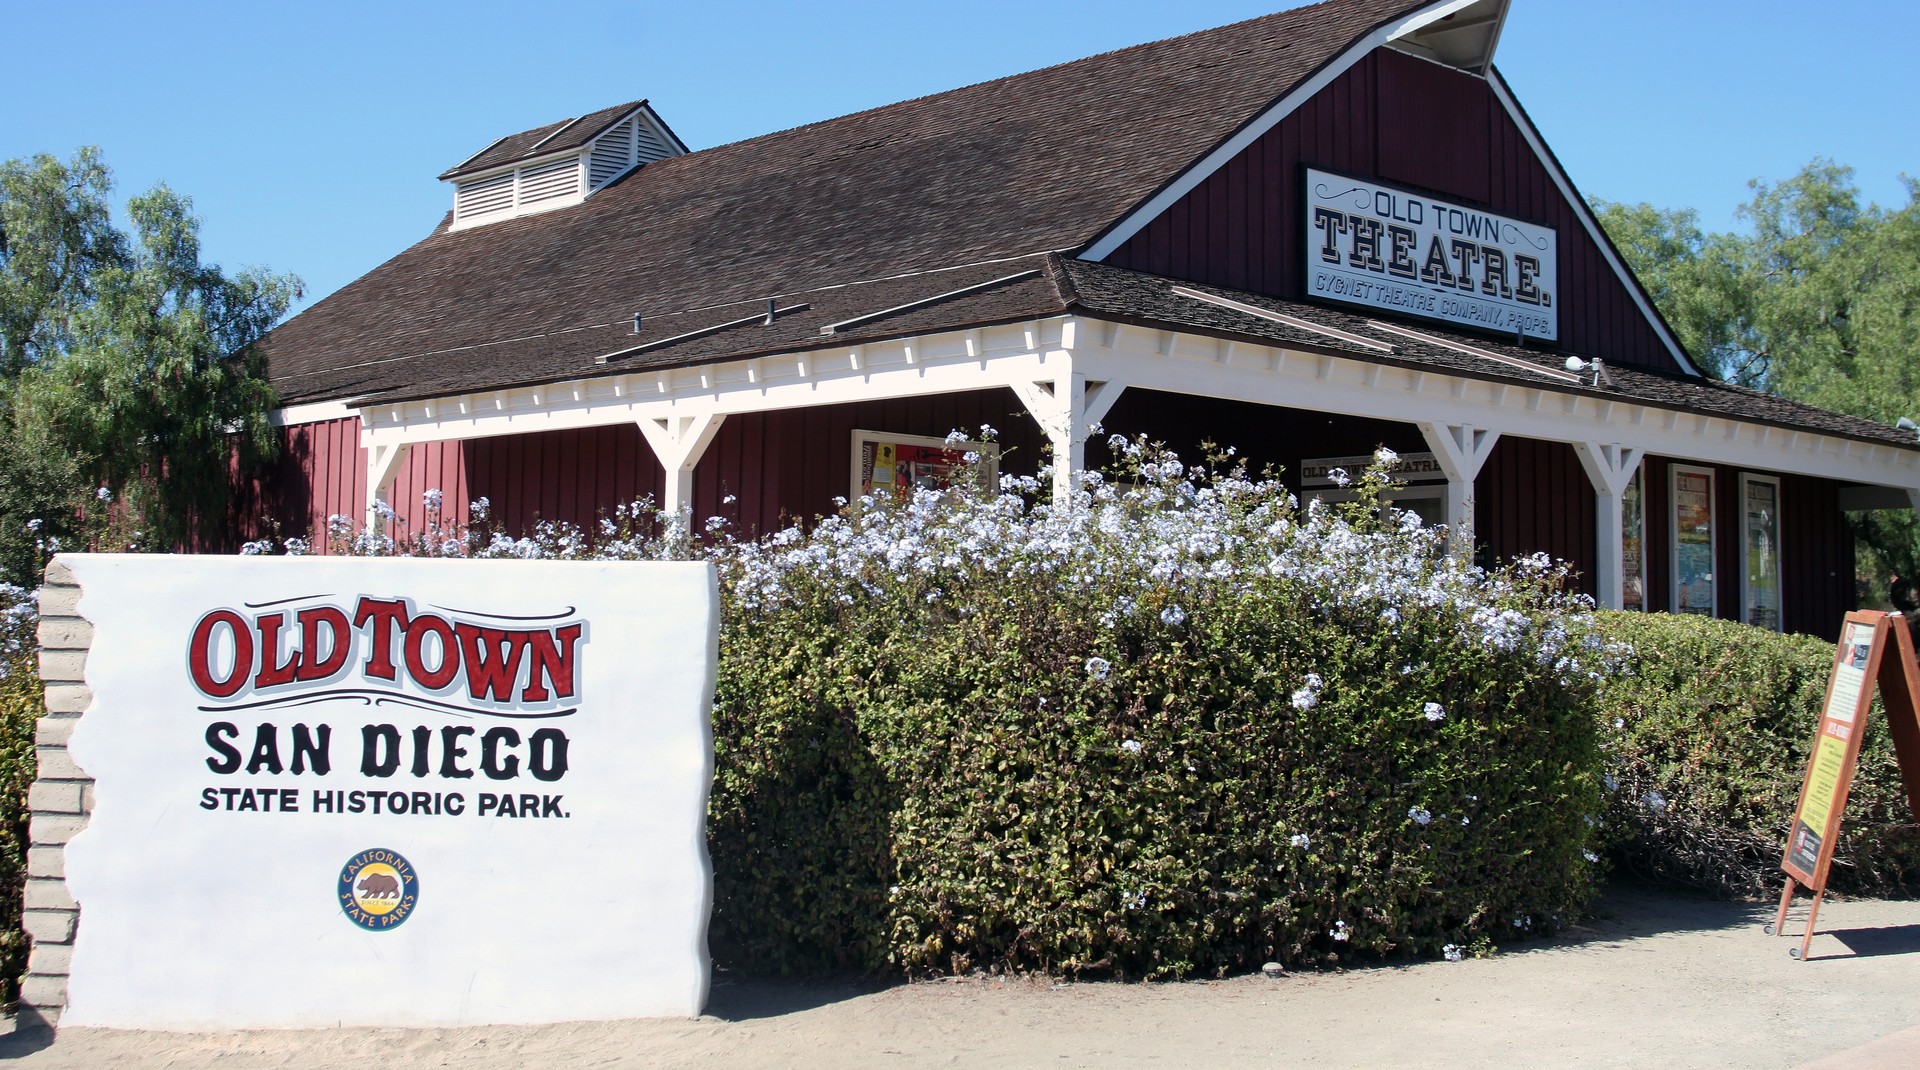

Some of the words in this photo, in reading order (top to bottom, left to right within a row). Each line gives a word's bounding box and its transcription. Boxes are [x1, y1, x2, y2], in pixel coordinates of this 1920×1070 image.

[1374, 190, 1424, 226] OLD
[1431, 204, 1501, 244] TOWN
[1313, 204, 1552, 308] THEATRE.
[1314, 271, 1374, 300] CYGNET
[1375, 282, 1437, 313] THEATRE
[1440, 298, 1504, 328] COMPANY,
[1506, 310, 1552, 336] PROPS.
[1302, 466, 1328, 479] OLD
[187, 602, 357, 700] OLD
[354, 594, 589, 708] TOWN
[204, 721, 333, 777] SAN
[359, 723, 571, 782] DIEGO
[199, 787, 300, 812] STATE
[313, 789, 467, 817] HISTORIC
[478, 792, 571, 819] PARK.
[342, 850, 415, 885] CALIFORNIA
[341, 892, 376, 927] STATE
[381, 893, 415, 927] PARKS
